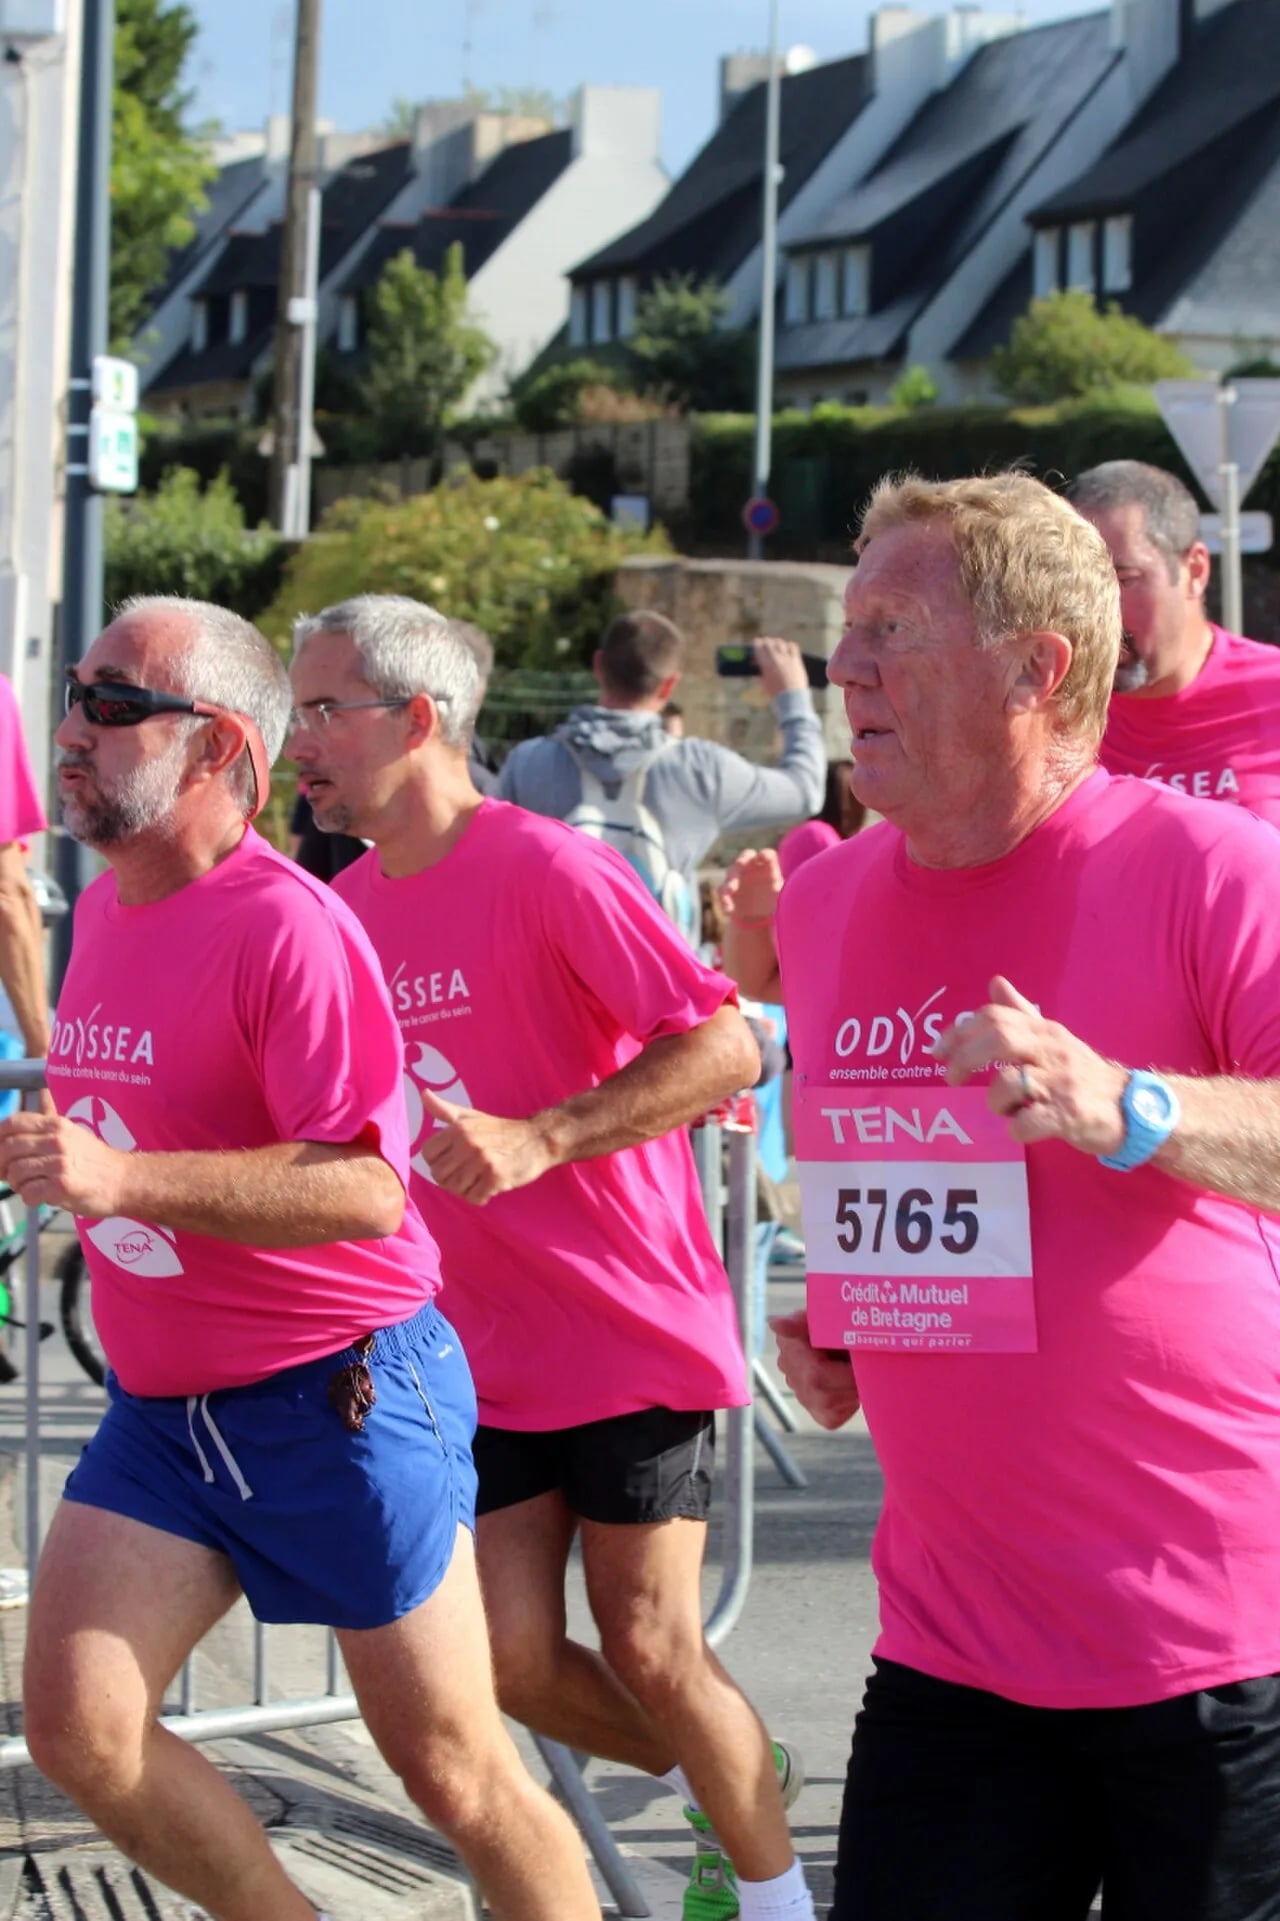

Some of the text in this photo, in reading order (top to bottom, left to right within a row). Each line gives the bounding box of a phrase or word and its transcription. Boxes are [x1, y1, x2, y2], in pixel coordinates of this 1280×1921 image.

[118, 1069, 129, 1082] du
[131, 1072, 151, 1086] sein
[829, 1065, 888, 1080] ensemble
[891, 1064, 932, 1079] contre
[934, 1062, 947, 1076] le
[821, 1106, 974, 1145] TENA
[836, 1188, 979, 1255] 5765
[114, 1242, 153, 1254] TENA
[841, 1281, 968, 1304] Crédit Mutuel
[852, 1306, 952, 1333] de Bretagne
[902, 1337, 924, 1348] qui
[928, 1337, 972, 1349] parler
